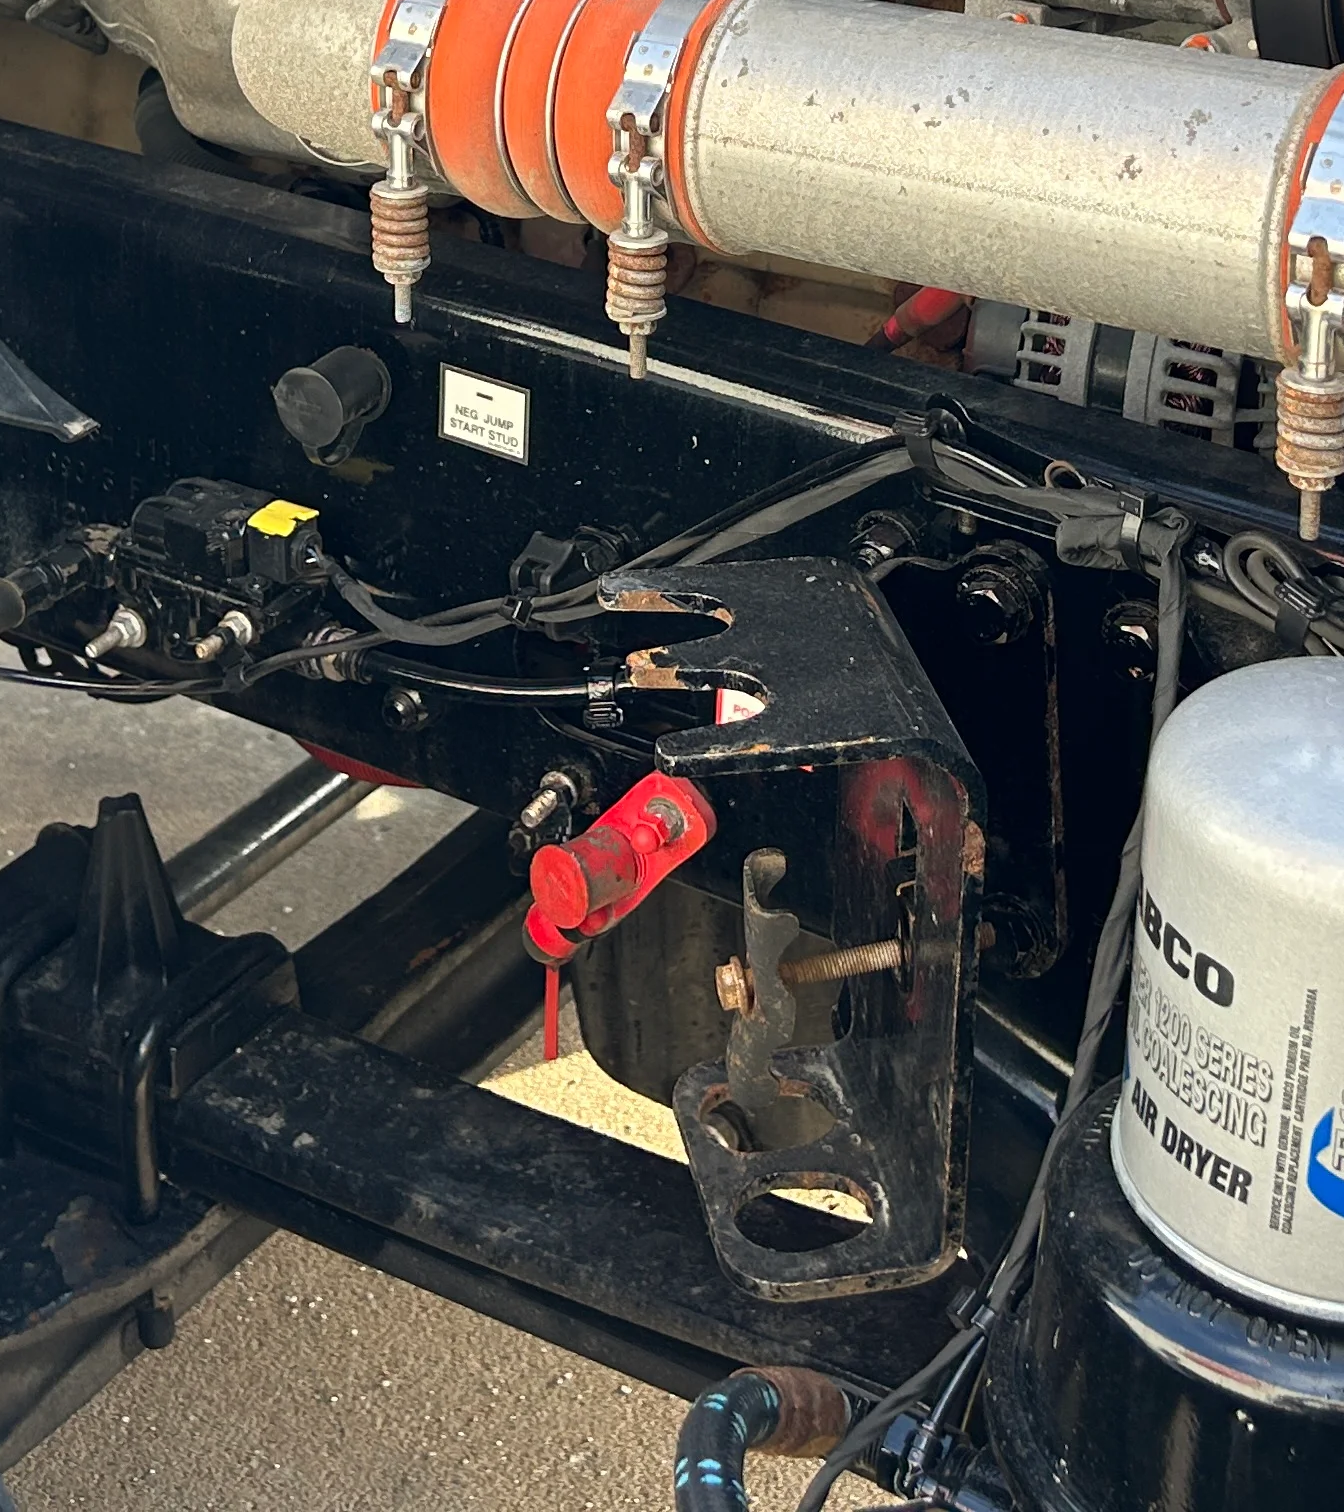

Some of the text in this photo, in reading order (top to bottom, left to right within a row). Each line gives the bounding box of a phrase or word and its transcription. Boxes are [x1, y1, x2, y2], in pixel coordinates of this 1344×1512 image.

[449, 417, 486, 438] START
[487, 429, 519, 448] STUD
[455, 403, 514, 431] NEG JUMP
[1139, 883, 1236, 1009] BCO
[1155, 985, 1275, 1104] 1200 SERIES
[1142, 1017, 1269, 1149] COALESCING
[1130, 1075, 1159, 1139] AIR
[1160, 1115, 1254, 1206] DRYER
[1275, 1150, 1288, 1174] WITH
[1269, 1195, 1283, 1232] SERVICE
[1245, 1315, 1334, 1365] OPEN
